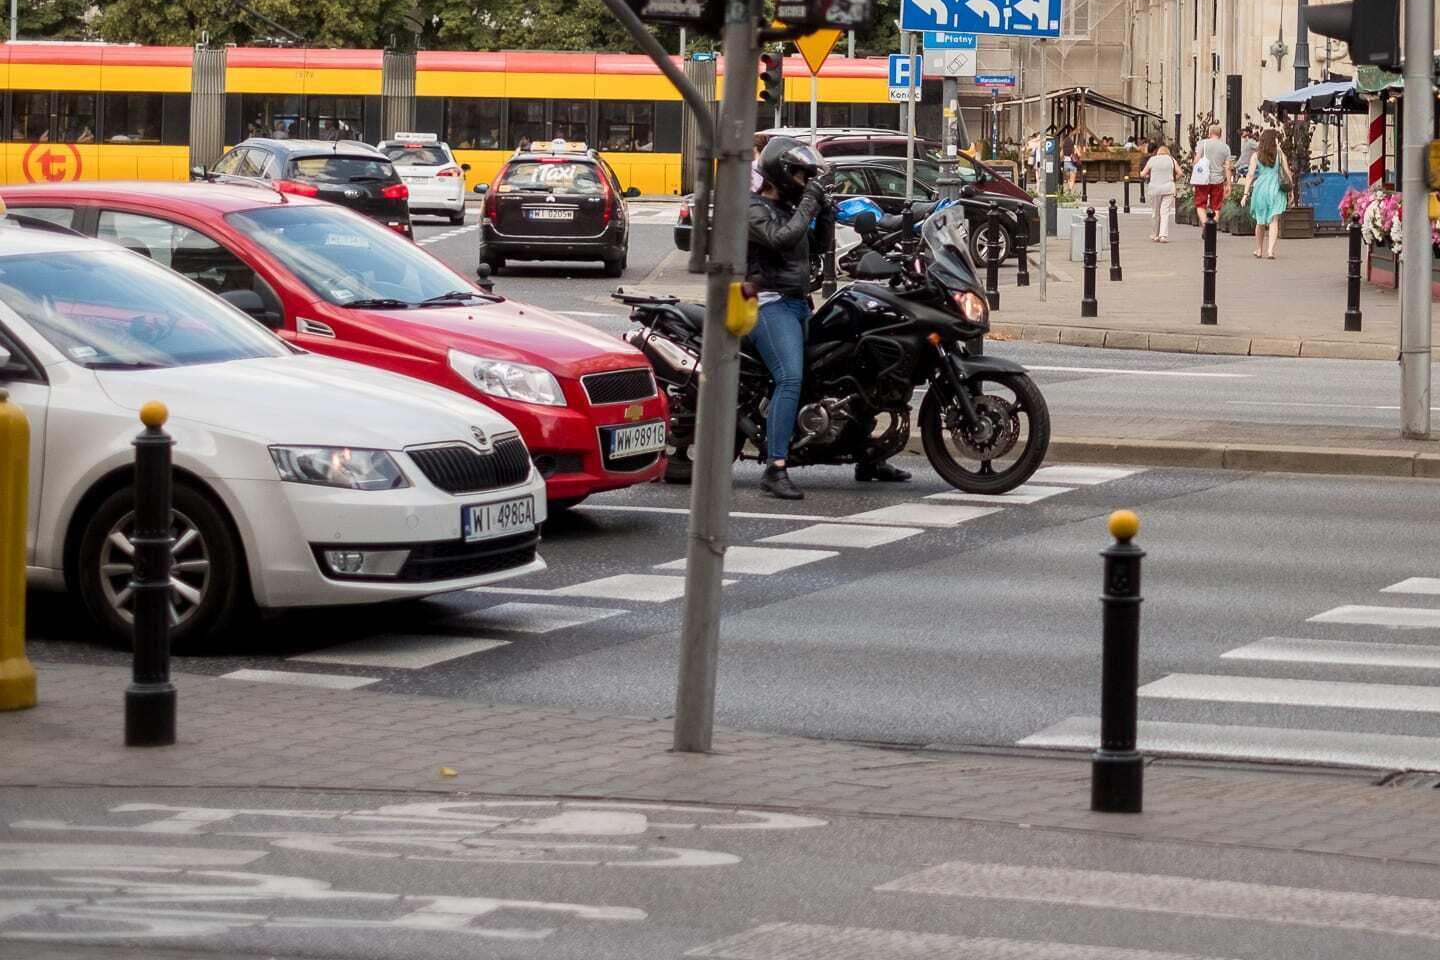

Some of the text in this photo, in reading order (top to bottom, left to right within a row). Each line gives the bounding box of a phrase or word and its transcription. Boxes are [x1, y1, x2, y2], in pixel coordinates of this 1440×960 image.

[945, 35, 973, 45] Płatny
[531, 164, 577, 183] iTaxi
[617, 424, 665, 451] WW 9891G
[473, 498, 532, 532] WI 498GA
